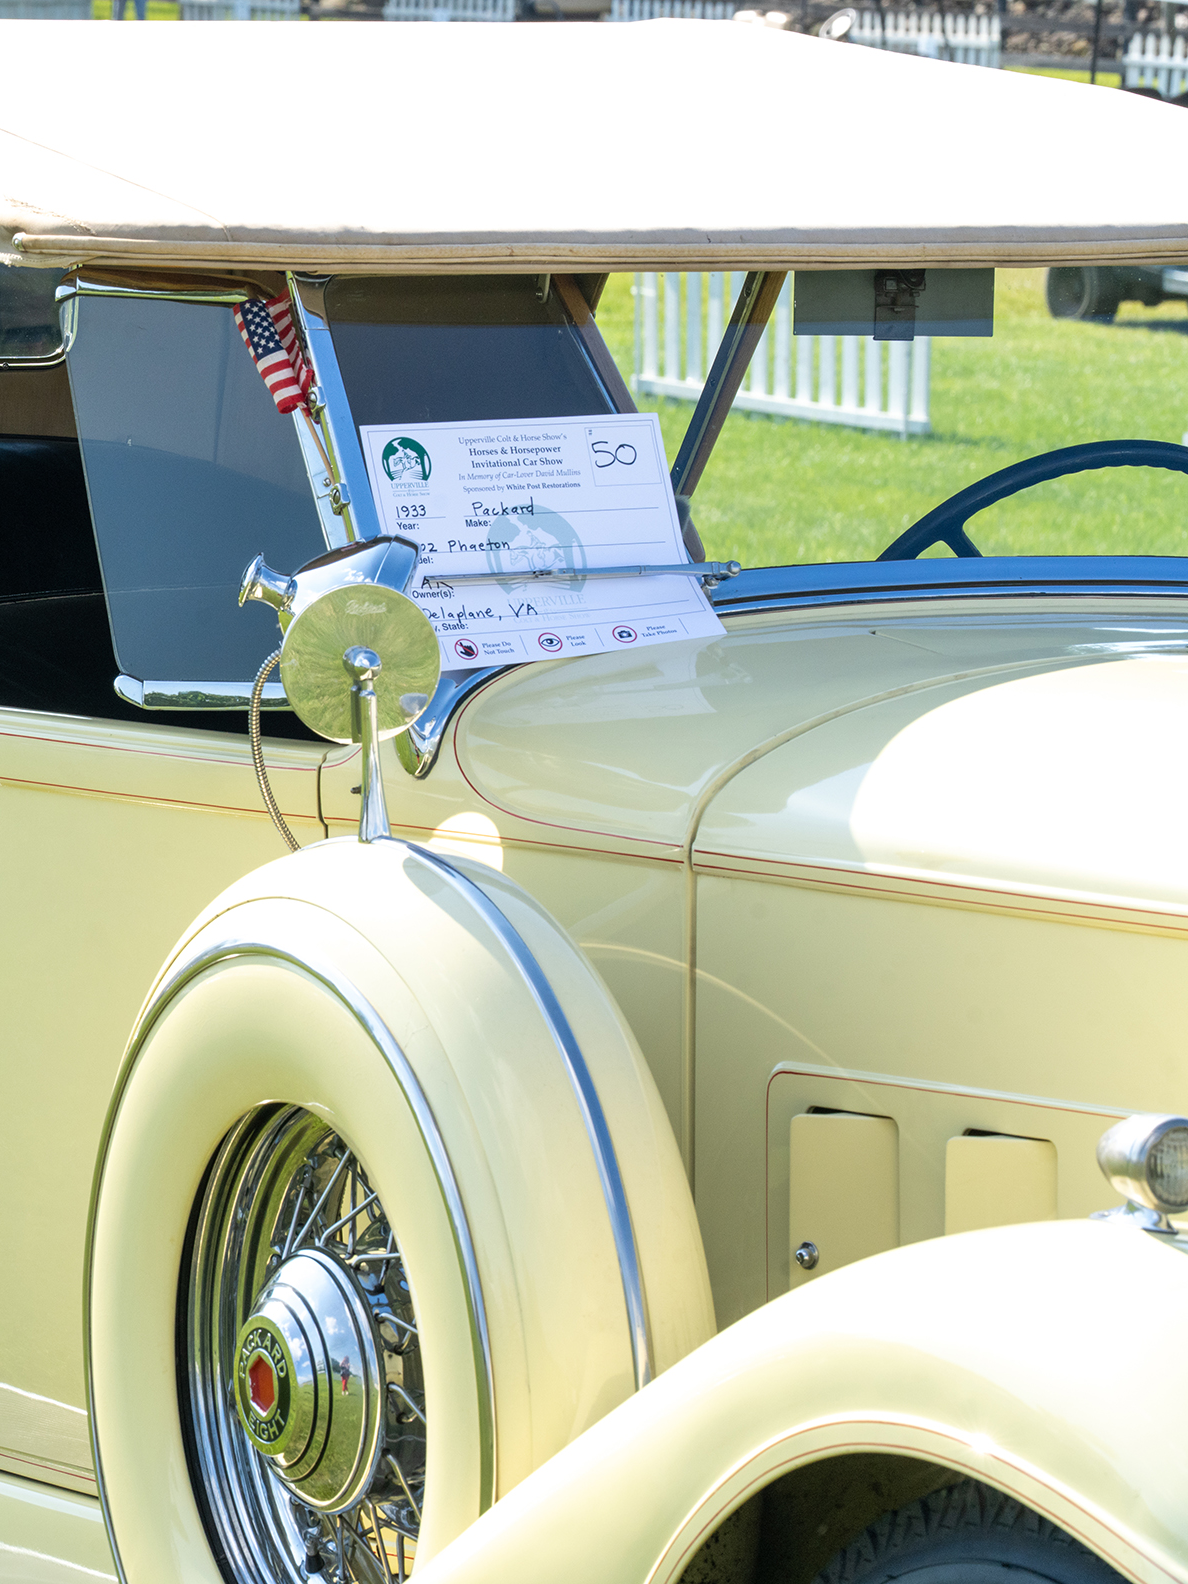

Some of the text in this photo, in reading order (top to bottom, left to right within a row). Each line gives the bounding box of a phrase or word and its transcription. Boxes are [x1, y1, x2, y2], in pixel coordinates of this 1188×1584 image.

[458, 436, 495, 446] Upperville
[513, 434, 519, 442] &
[520, 434, 541, 442] Horse
[541, 433, 567, 441] Show's
[469, 445, 561, 456] Horses & Horsepower
[591, 440, 637, 468] 50
[471, 457, 563, 469] Invitational Car Show
[458, 473, 466, 481] In
[467, 473, 493, 481] Memory
[495, 473, 501, 481] of
[502, 471, 534, 479] Car-Lover
[535, 469, 554, 478] David
[463, 481, 581, 494] Sponsored by White Post Restorations
[396, 504, 426, 518] 1933
[471, 496, 534, 516] Packard
[396, 522, 420, 530] Year:
[465, 519, 492, 527] Make:
[448, 538, 510, 553] Phaeton
[412, 590, 455, 599] Owner(s):
[508, 603, 538, 618] VA
[442, 623, 469, 631] State:
[239, 1329, 287, 1379] PACKARD
[249, 1408, 285, 1440] EIGHT
